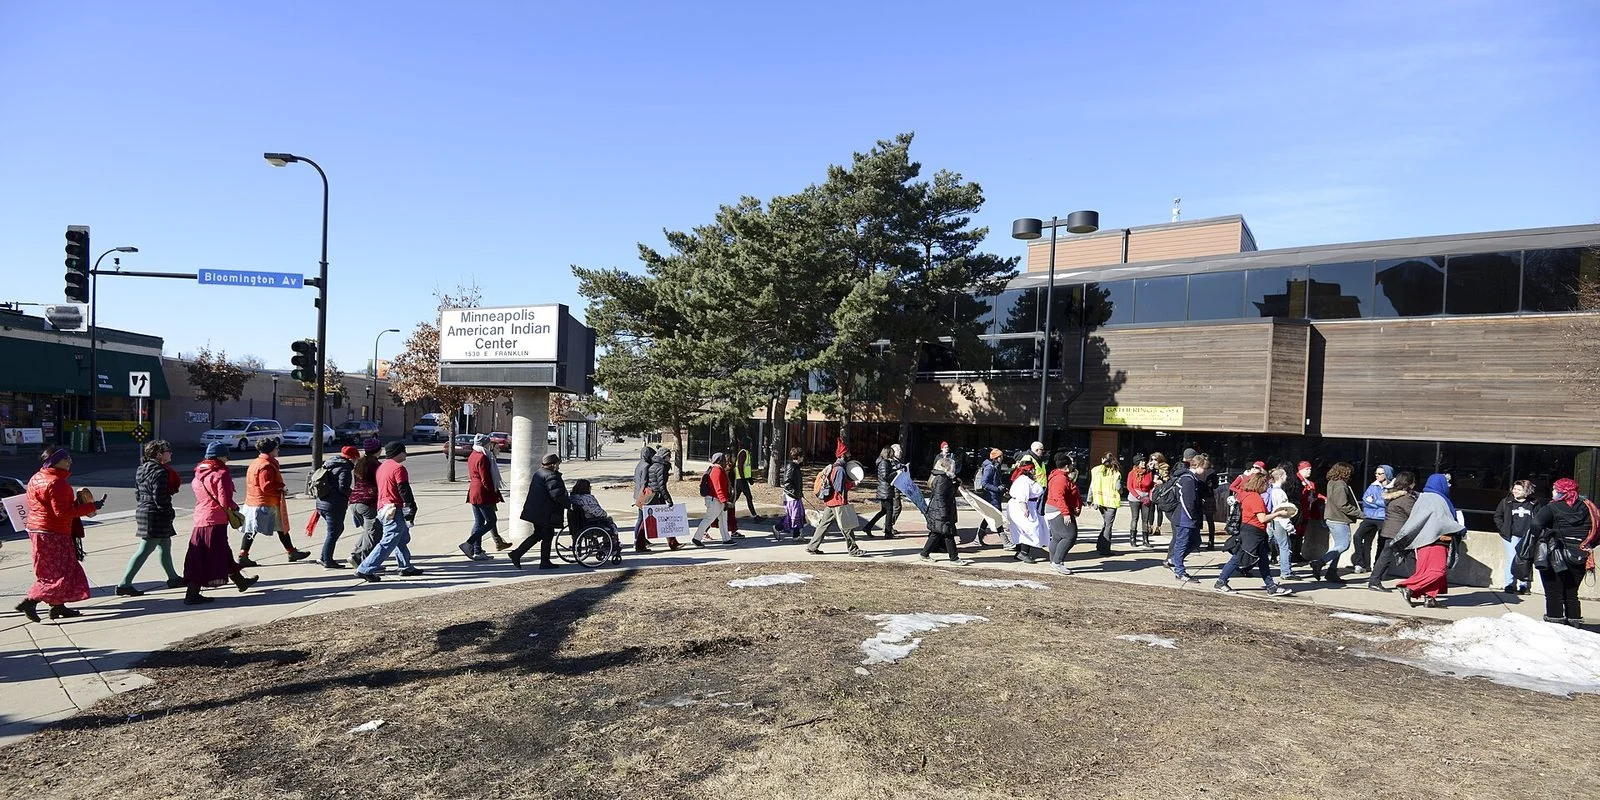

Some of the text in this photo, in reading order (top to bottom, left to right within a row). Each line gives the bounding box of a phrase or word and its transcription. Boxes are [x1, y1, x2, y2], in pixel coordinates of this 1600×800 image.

[204, 272, 297, 286] Bloomington Av
[460, 309, 535, 324] Minneapolis
[447, 323, 550, 336] American Indian
[475, 337, 518, 349] Center
[16, 504, 27, 520] YOU
